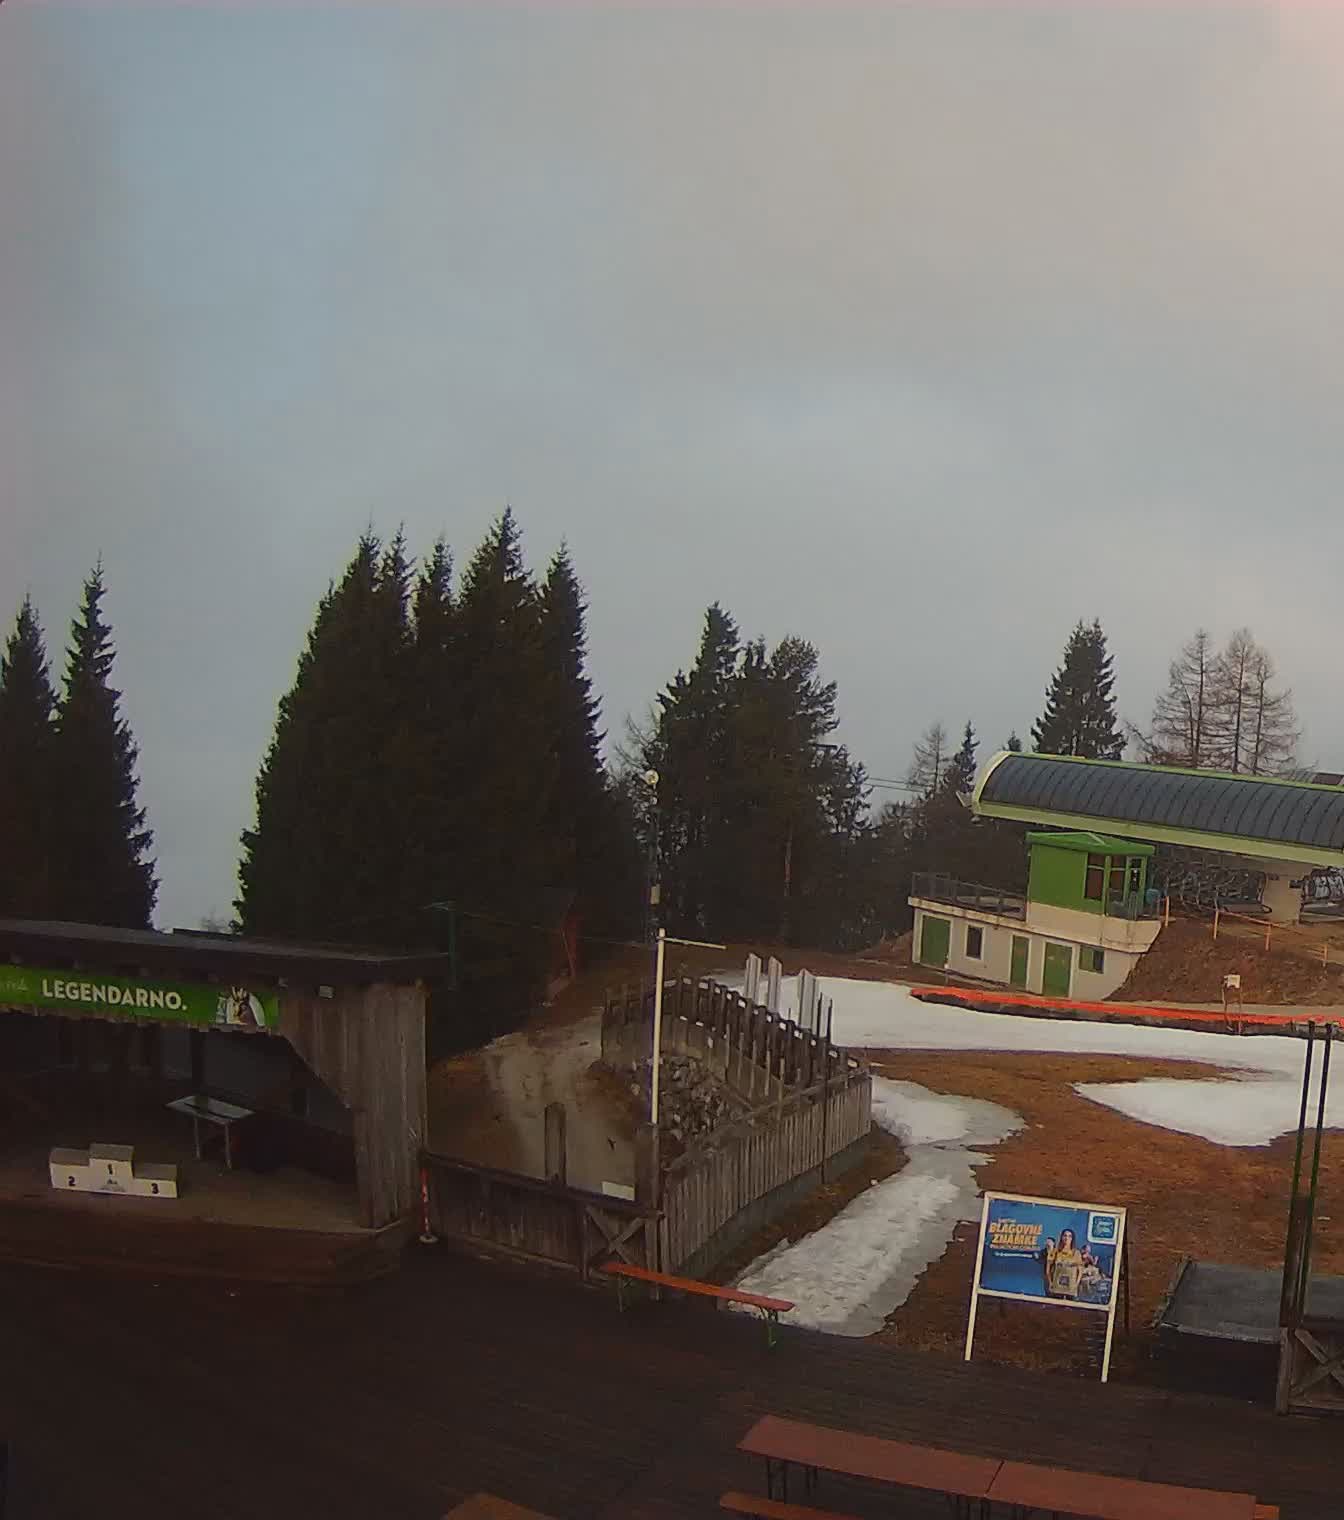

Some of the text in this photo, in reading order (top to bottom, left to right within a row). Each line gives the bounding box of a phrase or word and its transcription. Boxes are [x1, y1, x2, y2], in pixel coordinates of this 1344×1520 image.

[41, 978, 188, 1011] LEGENDARNO.
[107, 1164, 113, 1175] 1
[68, 1176, 75, 1187] 2
[151, 1183, 159, 1194] 3
